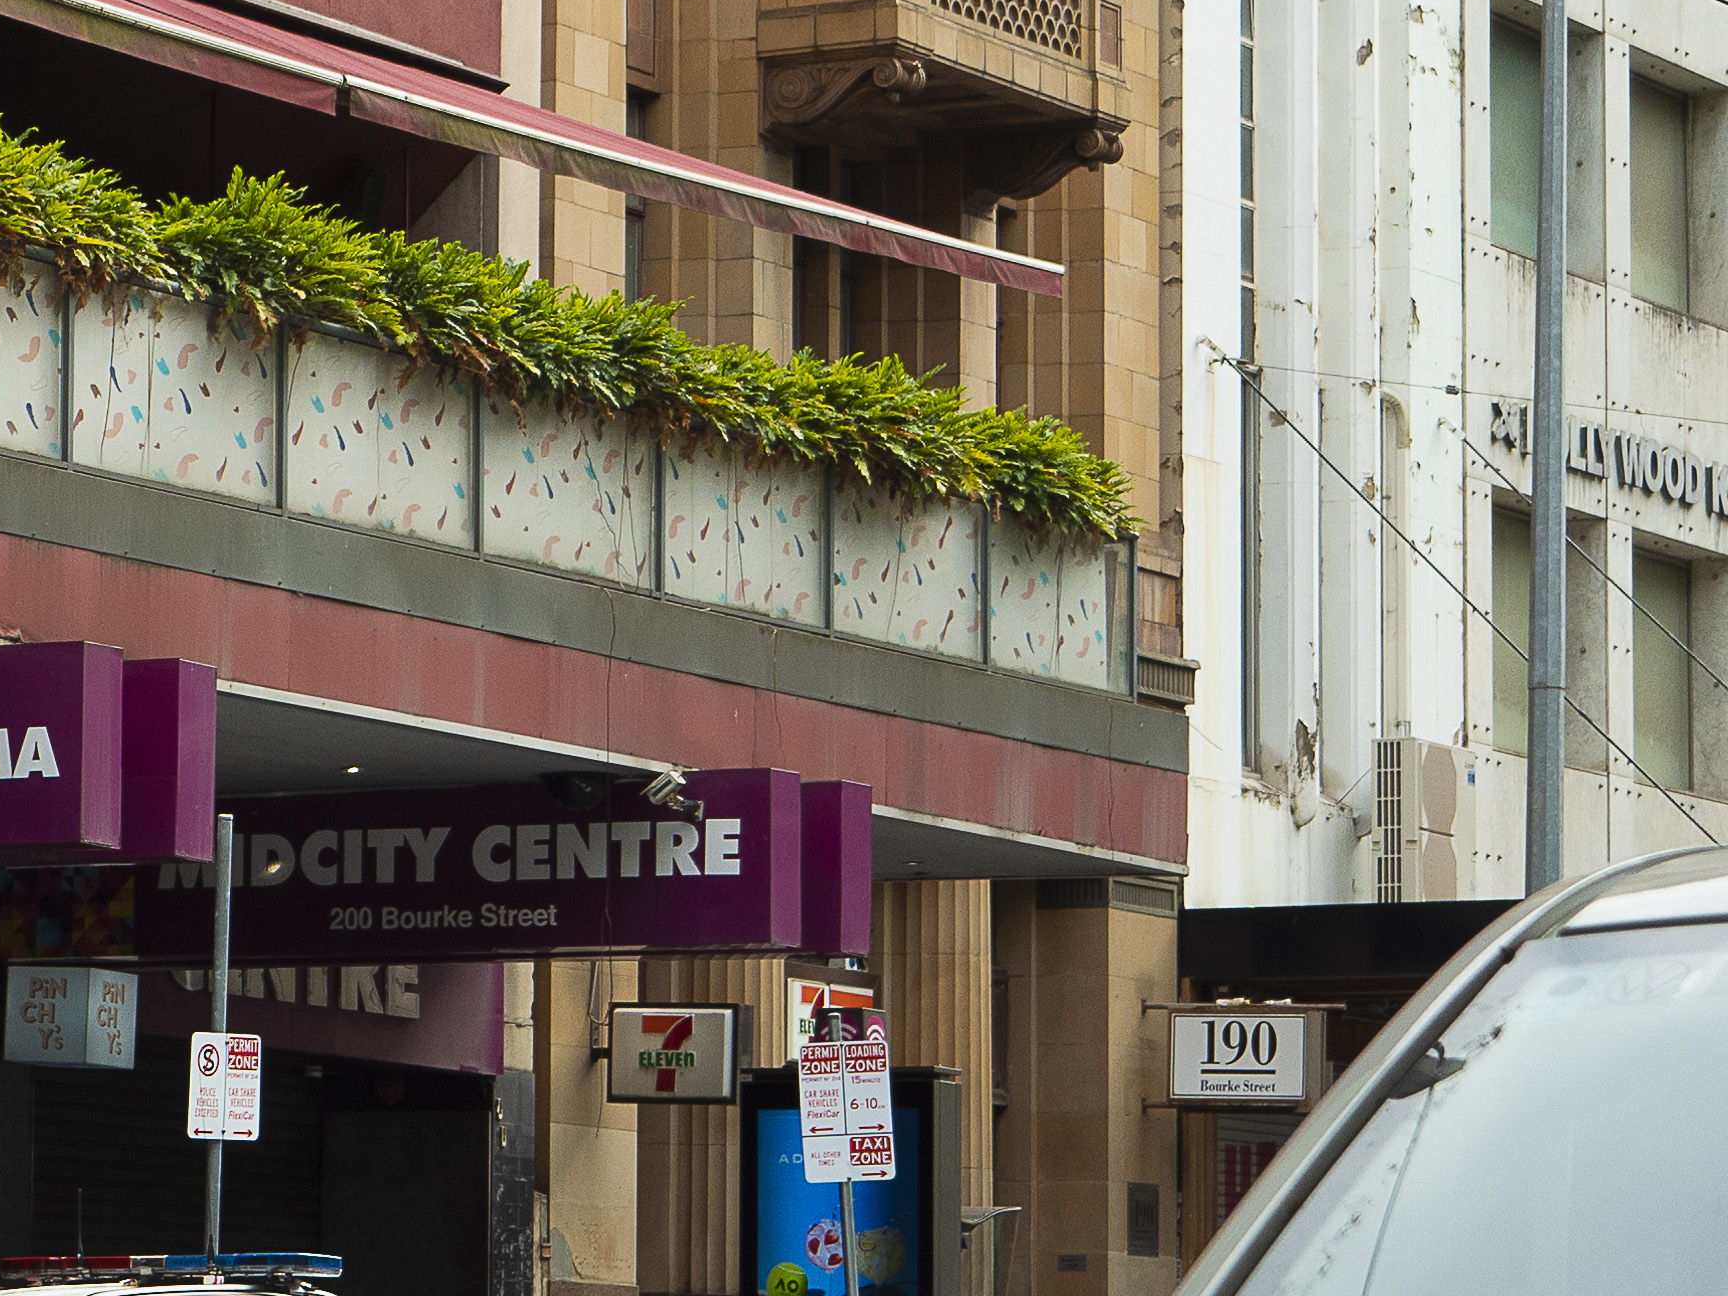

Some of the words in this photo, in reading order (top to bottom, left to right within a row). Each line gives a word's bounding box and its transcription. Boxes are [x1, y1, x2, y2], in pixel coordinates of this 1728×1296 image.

[472, 818, 741, 883] CENTRE
[329, 907, 372, 931] 200
[381, 905, 473, 930] Bourke
[481, 903, 558, 928] Street
[20, 1002, 57, 1024] CH
[96, 1005, 119, 1029] CH
[228, 1038, 259, 1053] PERMIT
[1200, 1020, 1278, 1065] 190
[641, 1014, 694, 1093] 7
[801, 1045, 839, 1060] PERMIT
[845, 1044, 884, 1058] LOADING
[228, 1055, 259, 1070] ZONE
[802, 1060, 841, 1075] ZONE
[845, 1058, 886, 1073] ZONE
[199, 1087, 217, 1097] POLICE
[228, 1087, 239, 1097] CAR
[240, 1087, 256, 1098] SHARE
[1200, 1079, 1241, 1092] Bourke
[1242, 1080, 1276, 1093] Street
[804, 1090, 818, 1099] CAR
[819, 1089, 840, 1099] SHARE
[196, 1098, 219, 1108] VEHICLES
[230, 1098, 254, 1108] VEHICLES
[808, 1098, 838, 1108] VEHICLES
[194, 1108, 219, 1118] EXCEPTED
[228, 1110, 255, 1120] FlexiCar
[807, 1109, 840, 1119] FlexiCar
[852, 1137, 888, 1151] TAXI
[810, 1151, 821, 1159] ALL
[822, 1150, 841, 1159] OTHER
[850, 1151, 892, 1166] ZONE
[817, 1159, 835, 1167] TIMES
